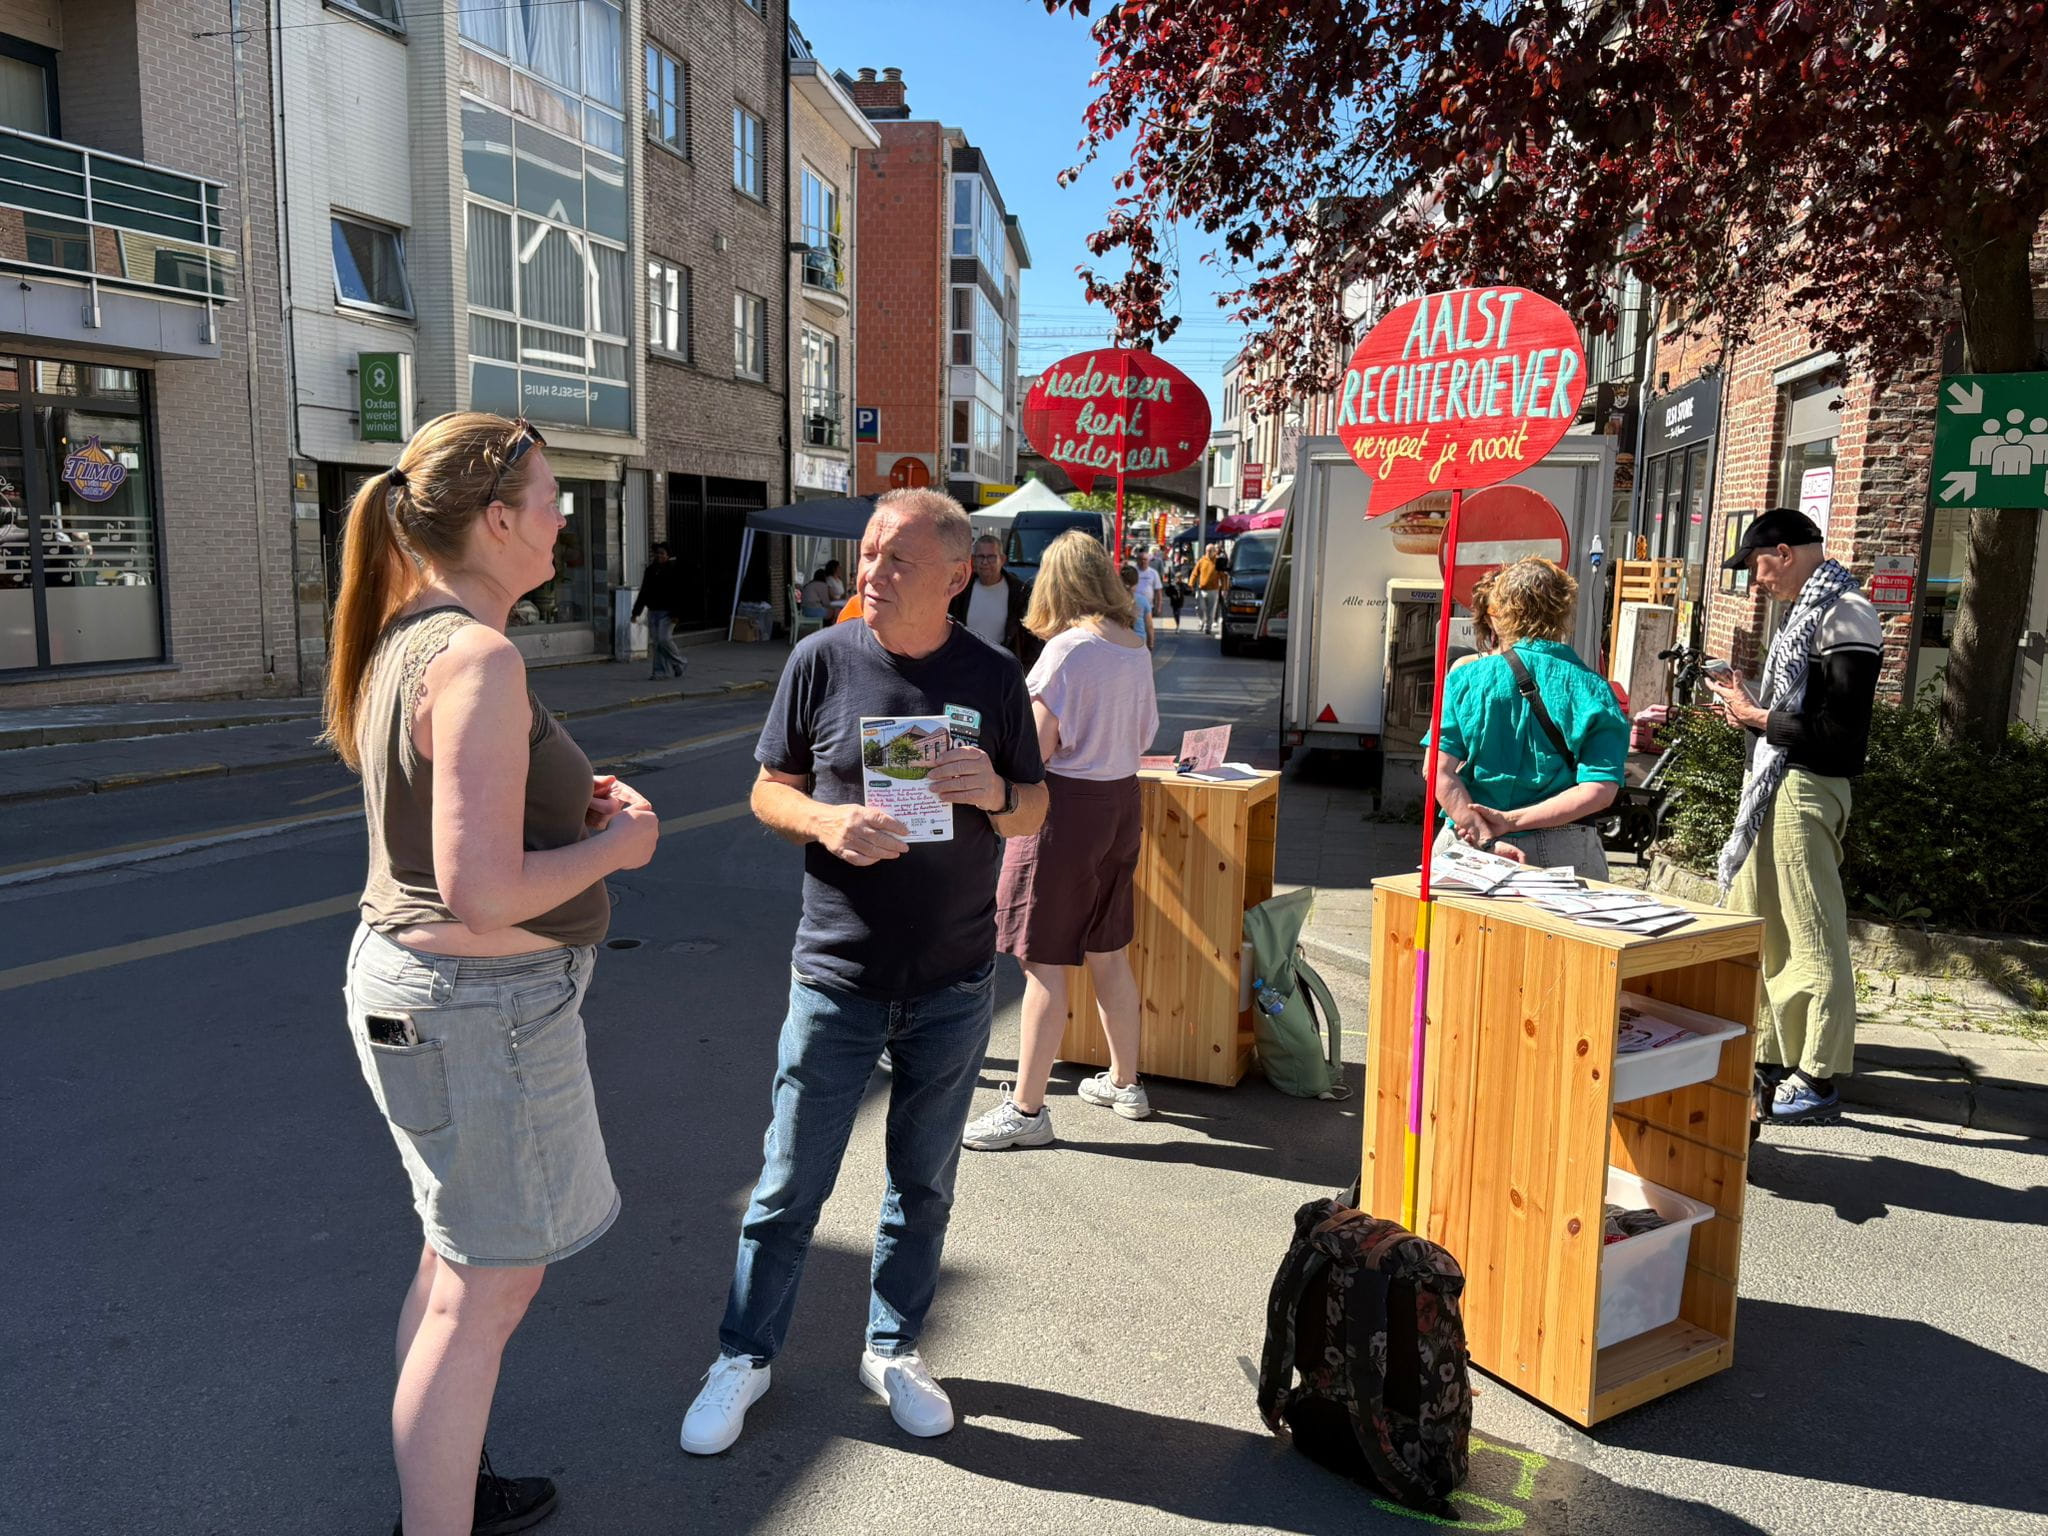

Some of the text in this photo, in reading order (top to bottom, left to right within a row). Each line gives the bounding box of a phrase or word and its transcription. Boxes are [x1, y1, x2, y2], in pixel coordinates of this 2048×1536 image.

[1402, 289, 1523, 361] AALST
[1337, 348, 1579, 427] RECHTEROEVER
[365, 398, 397, 409] Oxfam
[365, 410, 397, 420] wereld
[366, 422, 398, 432] winkel
[859, 410, 873, 429] P
[1075, 401, 1144, 436] kent
[1353, 420, 1529, 484] vergeet je nooit
[64, 456, 127, 484] TIMO
[1342, 596, 1364, 606] Alle
